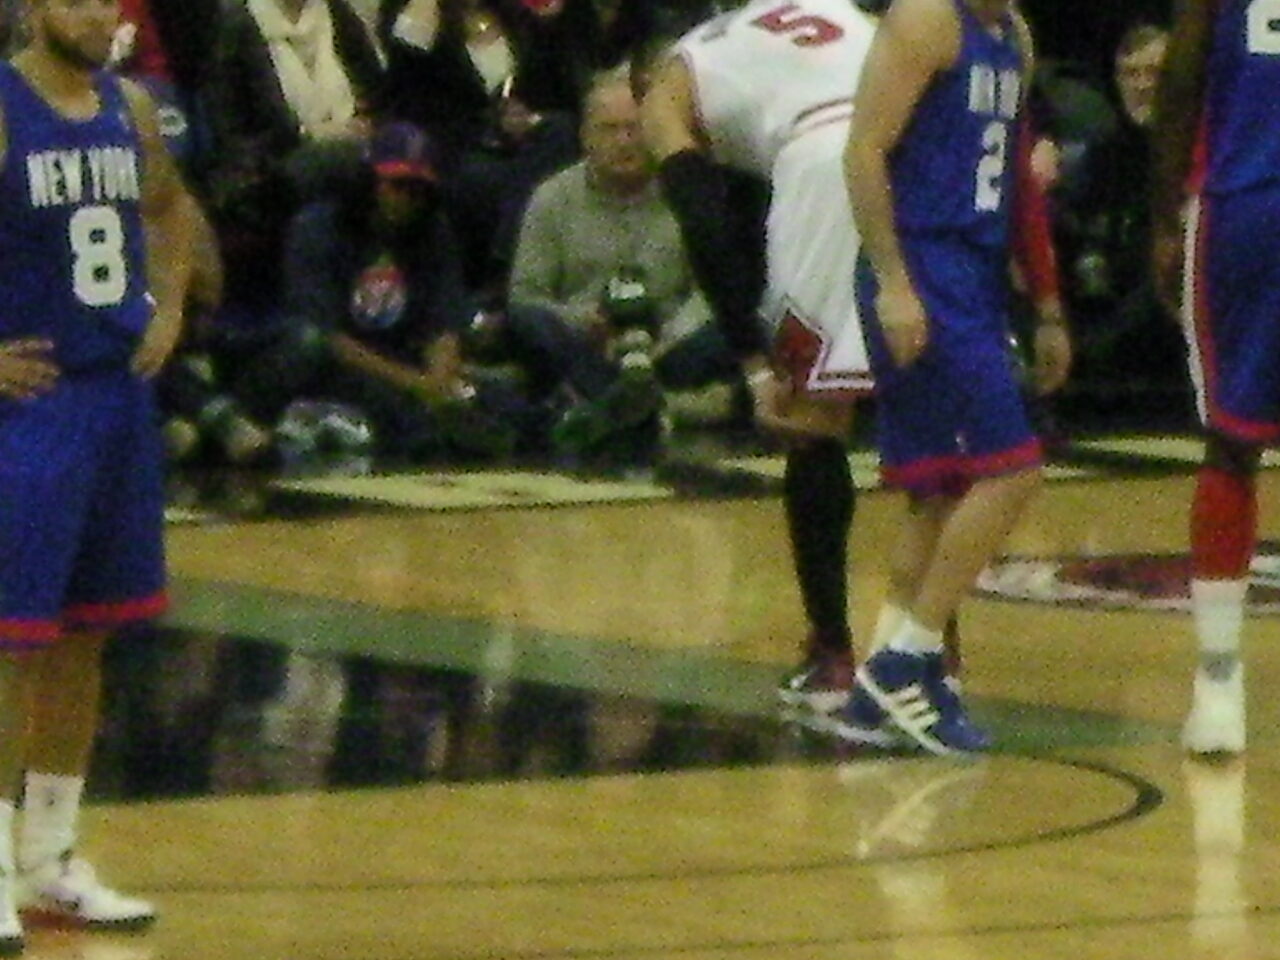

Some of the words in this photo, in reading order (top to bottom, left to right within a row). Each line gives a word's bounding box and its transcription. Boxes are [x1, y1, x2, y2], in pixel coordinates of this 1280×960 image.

[26, 149, 82, 208] NEW
[87, 144, 140, 201] YORK
[974, 120, 1007, 213] 2
[69, 204, 127, 307] 8
